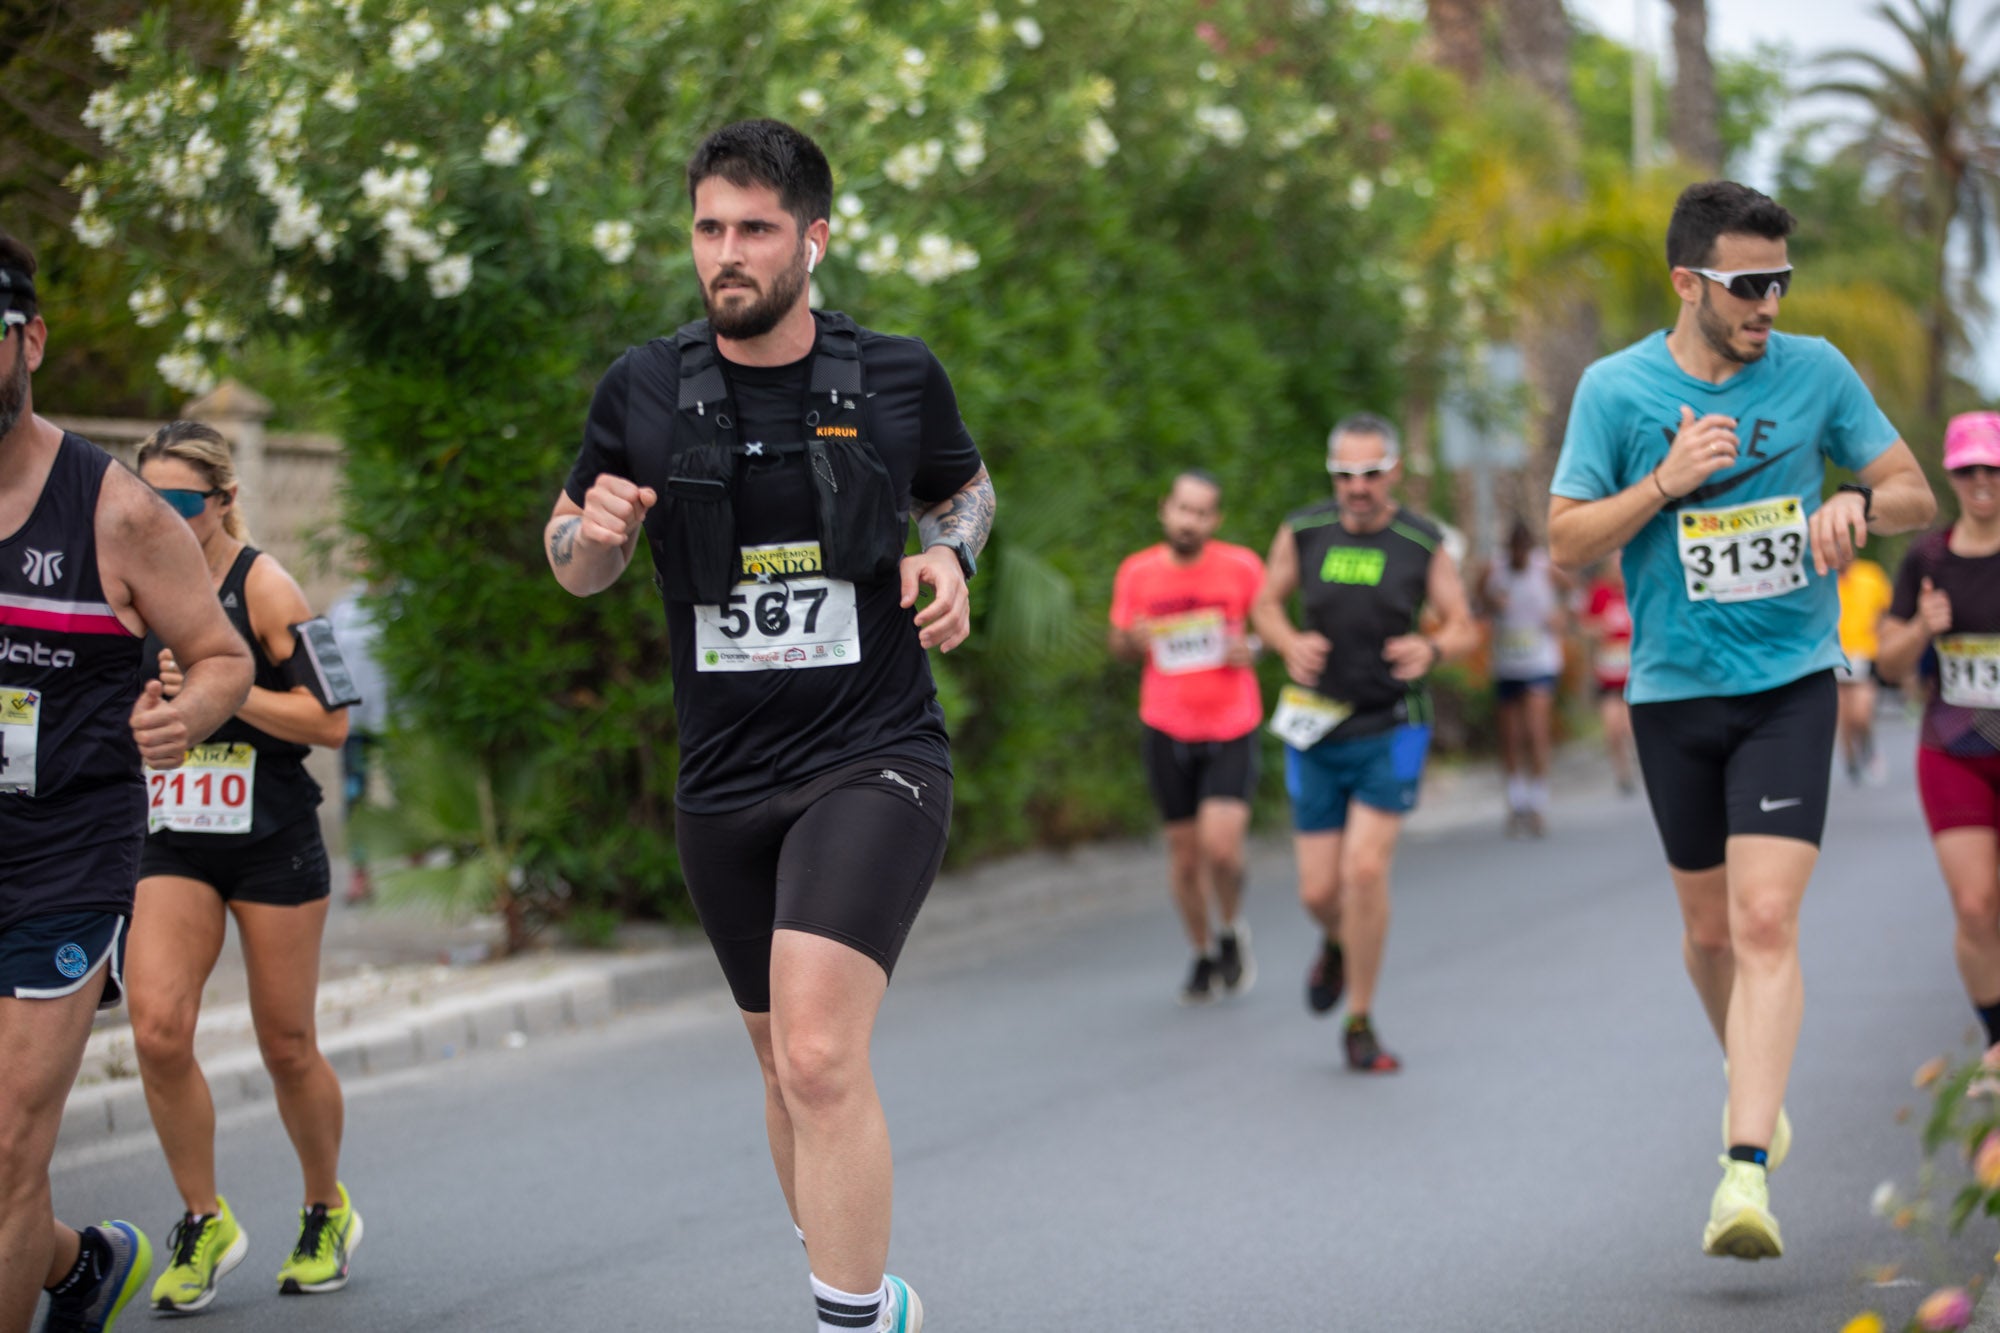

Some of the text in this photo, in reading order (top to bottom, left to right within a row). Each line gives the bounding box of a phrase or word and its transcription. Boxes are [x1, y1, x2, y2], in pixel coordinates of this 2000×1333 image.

[816, 426, 858, 438] KIPRUN
[743, 553, 767, 563] RAN
[769, 550, 808, 560] PREMIO
[744, 558, 817, 575] ONDO
[1689, 533, 1801, 577] 3133
[719, 588, 828, 639] 567
[151, 773, 246, 808] 2110
